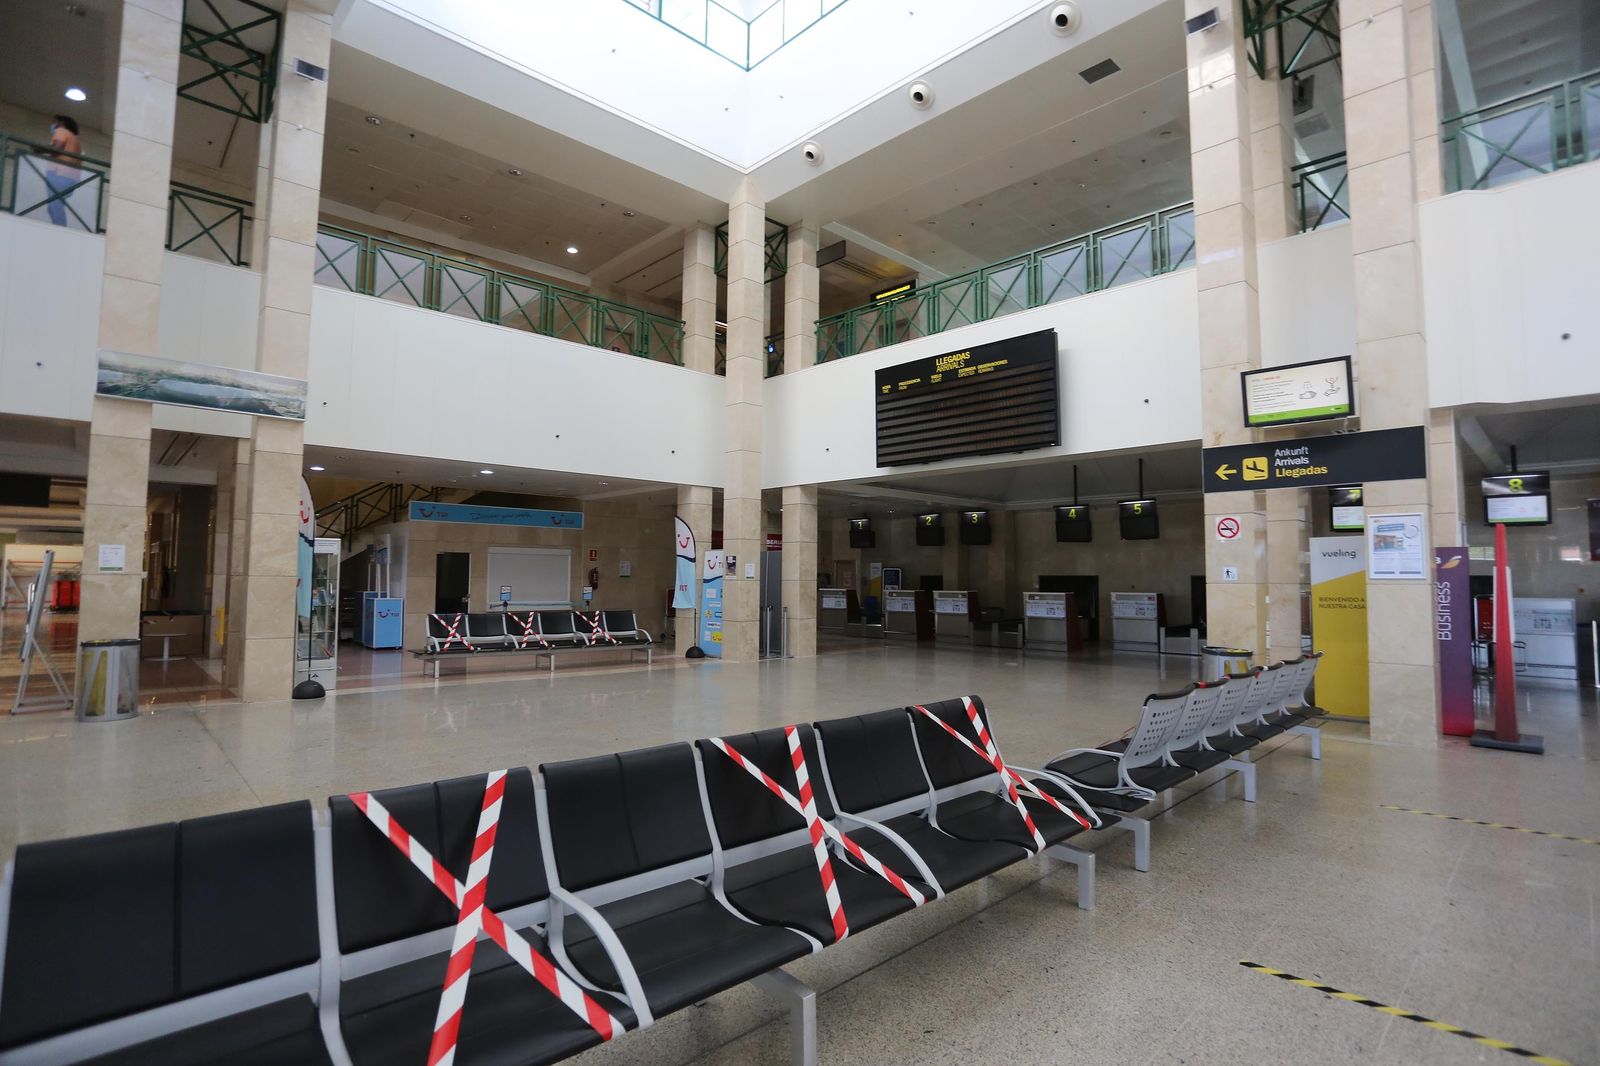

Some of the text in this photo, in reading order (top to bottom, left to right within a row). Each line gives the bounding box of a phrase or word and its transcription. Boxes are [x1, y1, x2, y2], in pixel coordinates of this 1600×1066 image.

[935, 351, 971, 366] LLEGADAS
[935, 360, 965, 373] ARRIVALS
[1274, 446, 1309, 457] Ankunft
[1274, 456, 1309, 467] Arrivals
[1275, 465, 1328, 478] Llegadas
[1508, 478, 1523, 493] 8
[1068, 508, 1077, 519] 4
[1133, 503, 1142, 515] 5
[925, 516, 932, 526] 2
[971, 513, 979, 524] 3
[857, 521, 863, 530] 1
[1321, 548, 1357, 560] vueling
